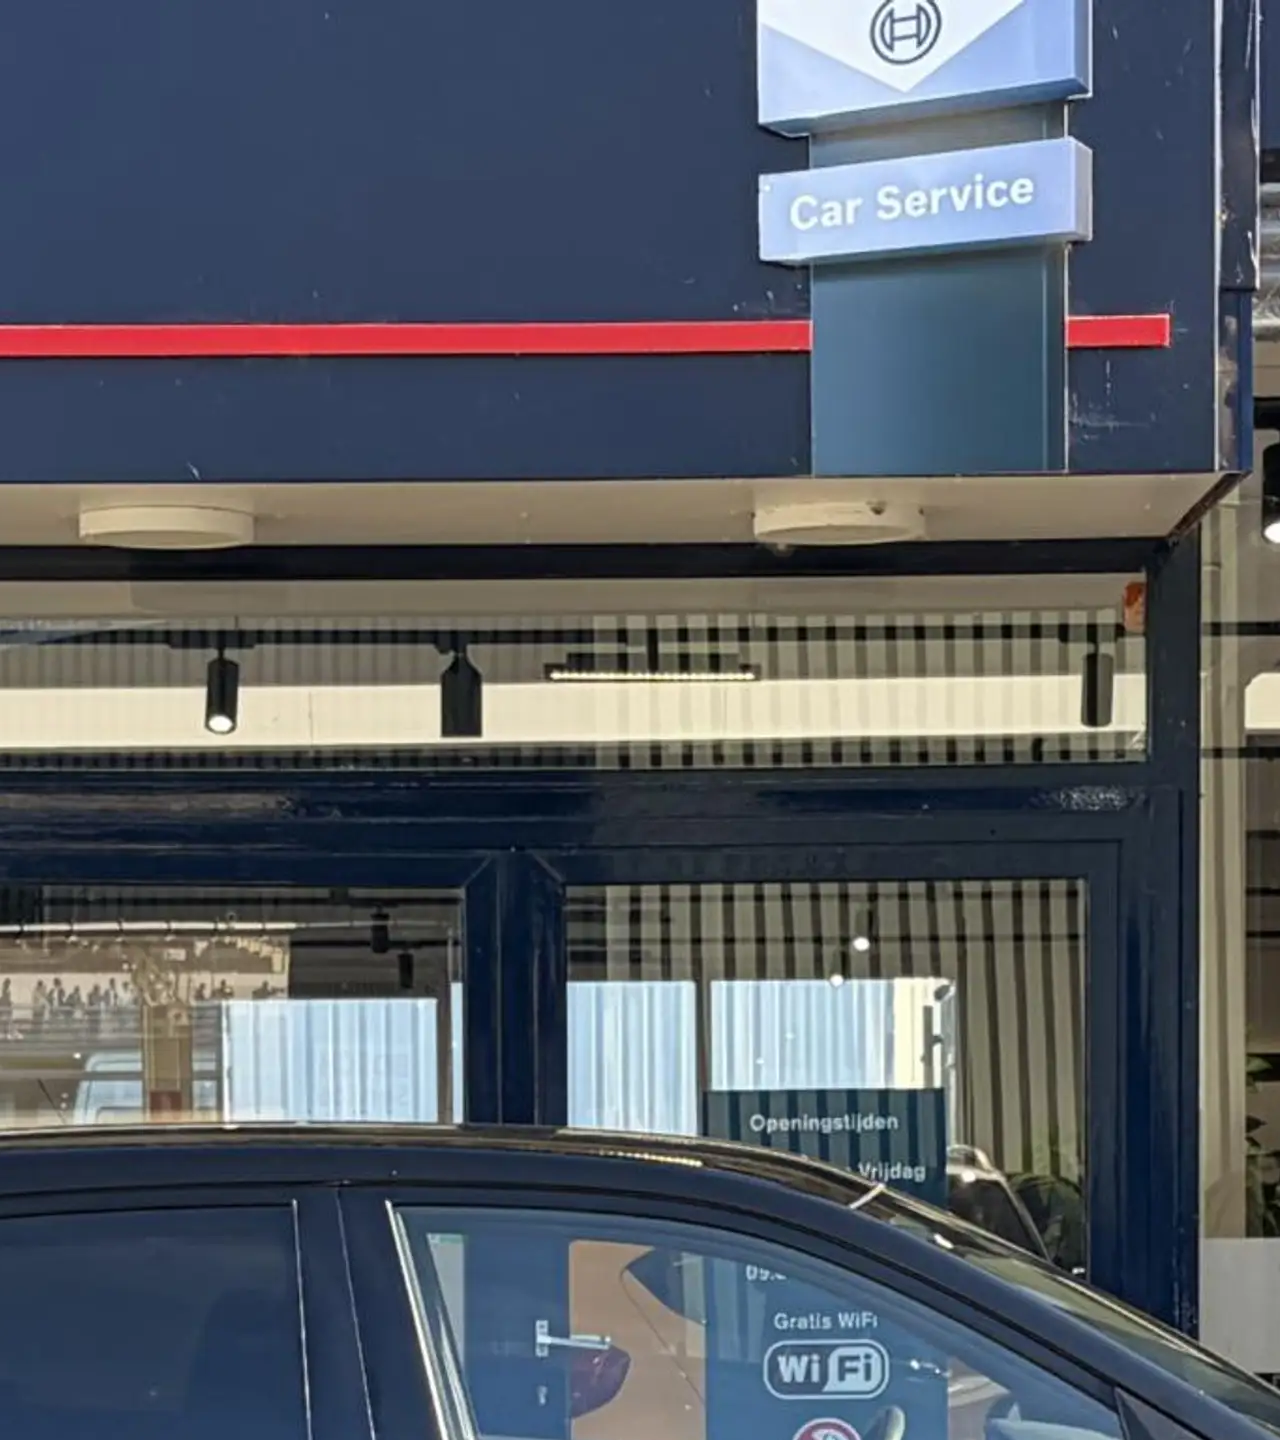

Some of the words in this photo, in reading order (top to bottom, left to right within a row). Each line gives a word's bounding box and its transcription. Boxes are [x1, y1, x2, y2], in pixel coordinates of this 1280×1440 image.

[789, 194, 862, 231] Car
[876, 174, 1034, 221] Service
[749, 1113, 899, 1133] Openingstijden
[858, 1162, 926, 1182] Vrijdag
[773, 1312, 832, 1329] Gratis
[837, 1312, 878, 1329] WiFi
